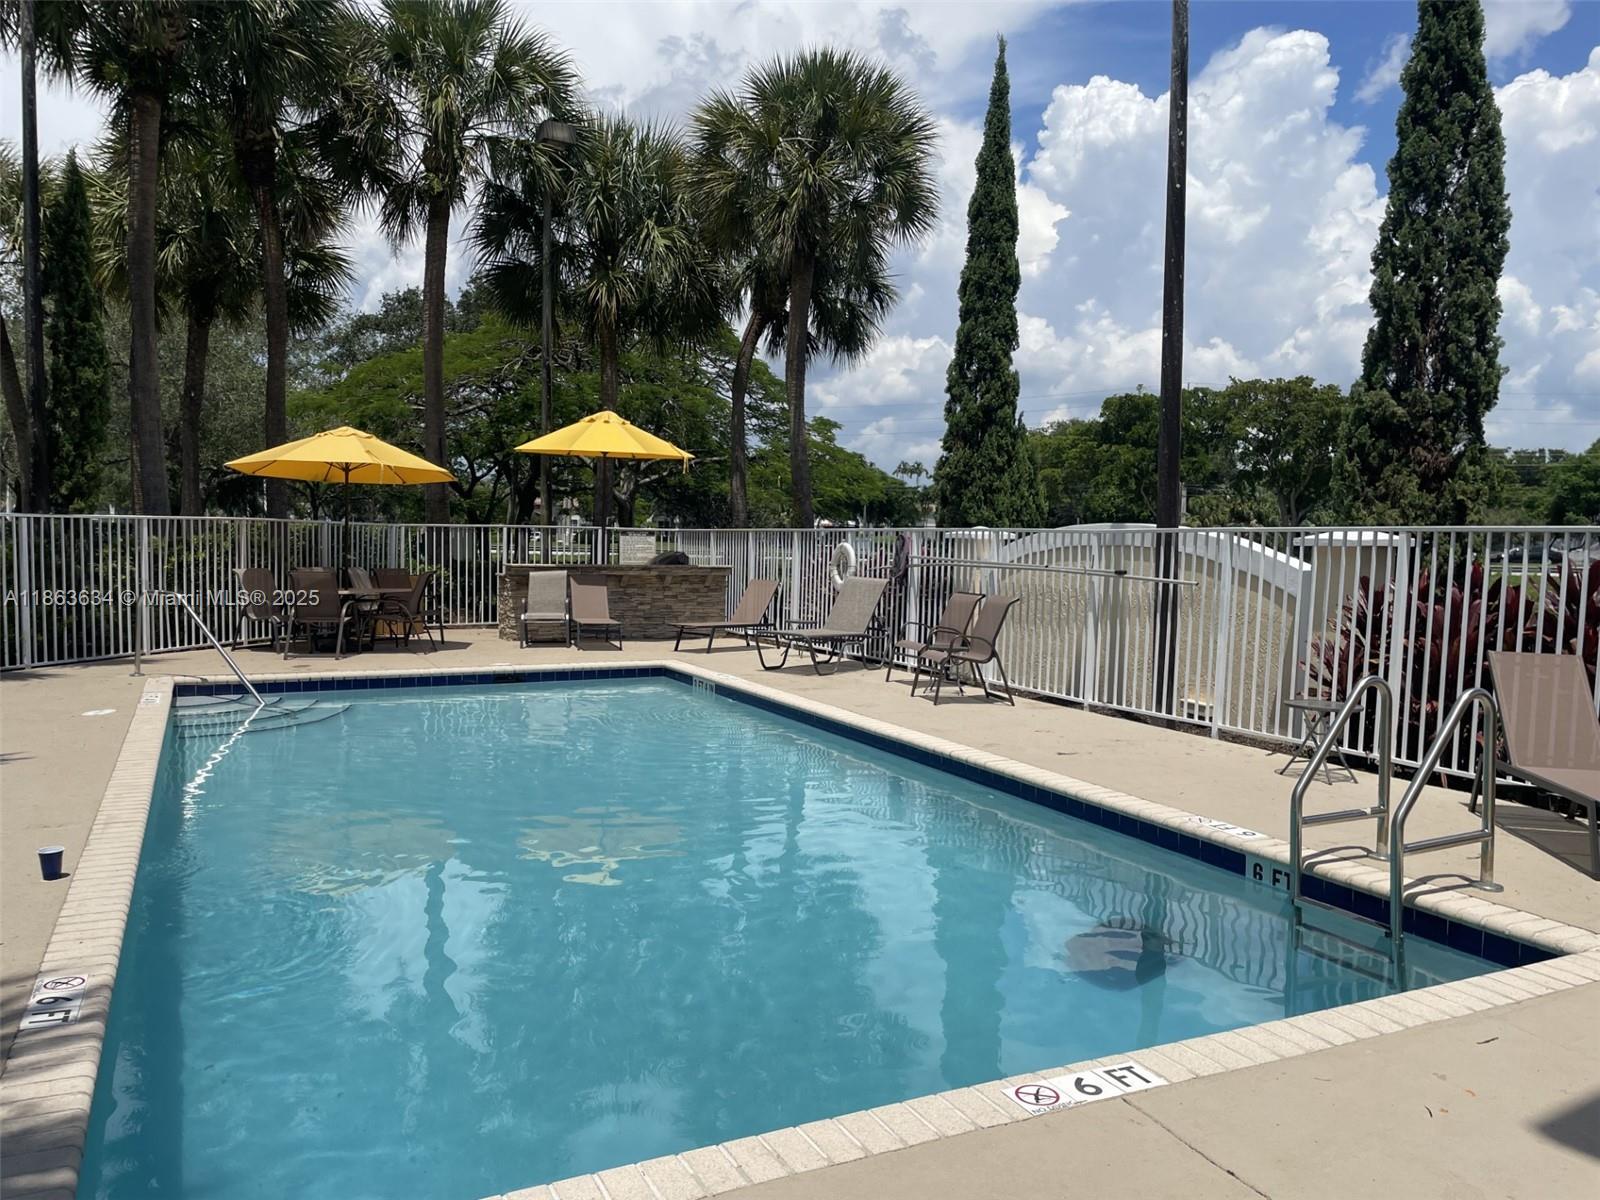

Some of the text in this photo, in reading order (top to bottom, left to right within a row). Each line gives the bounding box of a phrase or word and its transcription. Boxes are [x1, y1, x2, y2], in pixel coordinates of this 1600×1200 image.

[1253, 862, 1291, 891] 6 FT
[29, 996, 73, 1024] 6 FT
[1074, 1065, 1152, 1096] 6 FT
